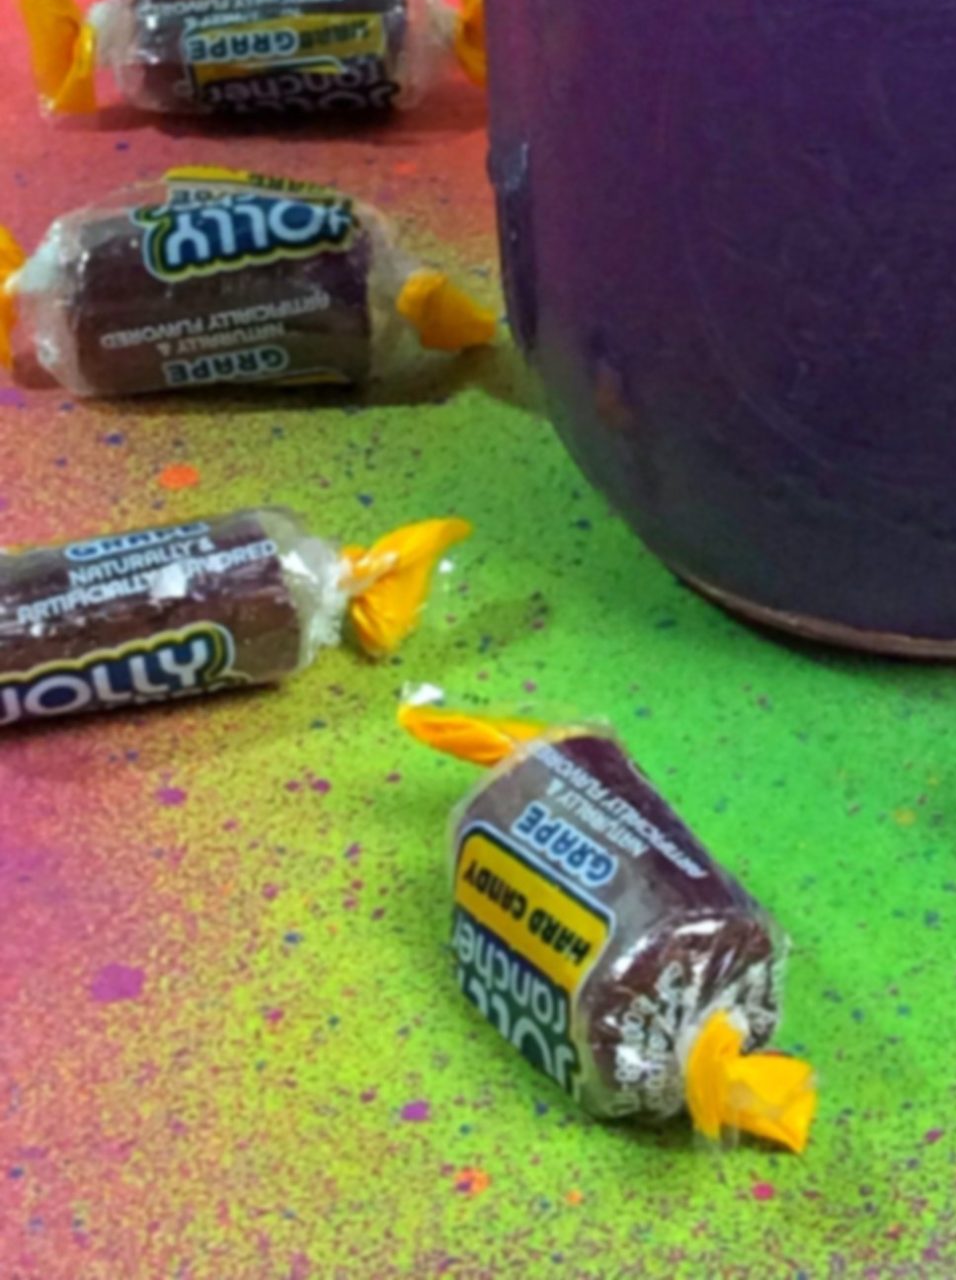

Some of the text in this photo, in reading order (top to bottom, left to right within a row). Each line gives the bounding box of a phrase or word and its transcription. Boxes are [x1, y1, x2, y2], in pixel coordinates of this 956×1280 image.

[186, 29, 297, 60] GRAPE
[167, 346, 287, 384] GRAPE
[69, 540, 195, 586] NATURALLY
[0, 638, 208, 723] JOLLY
[514, 805, 616, 885] GRAPE
[463, 860, 593, 966] HARD CANDY
